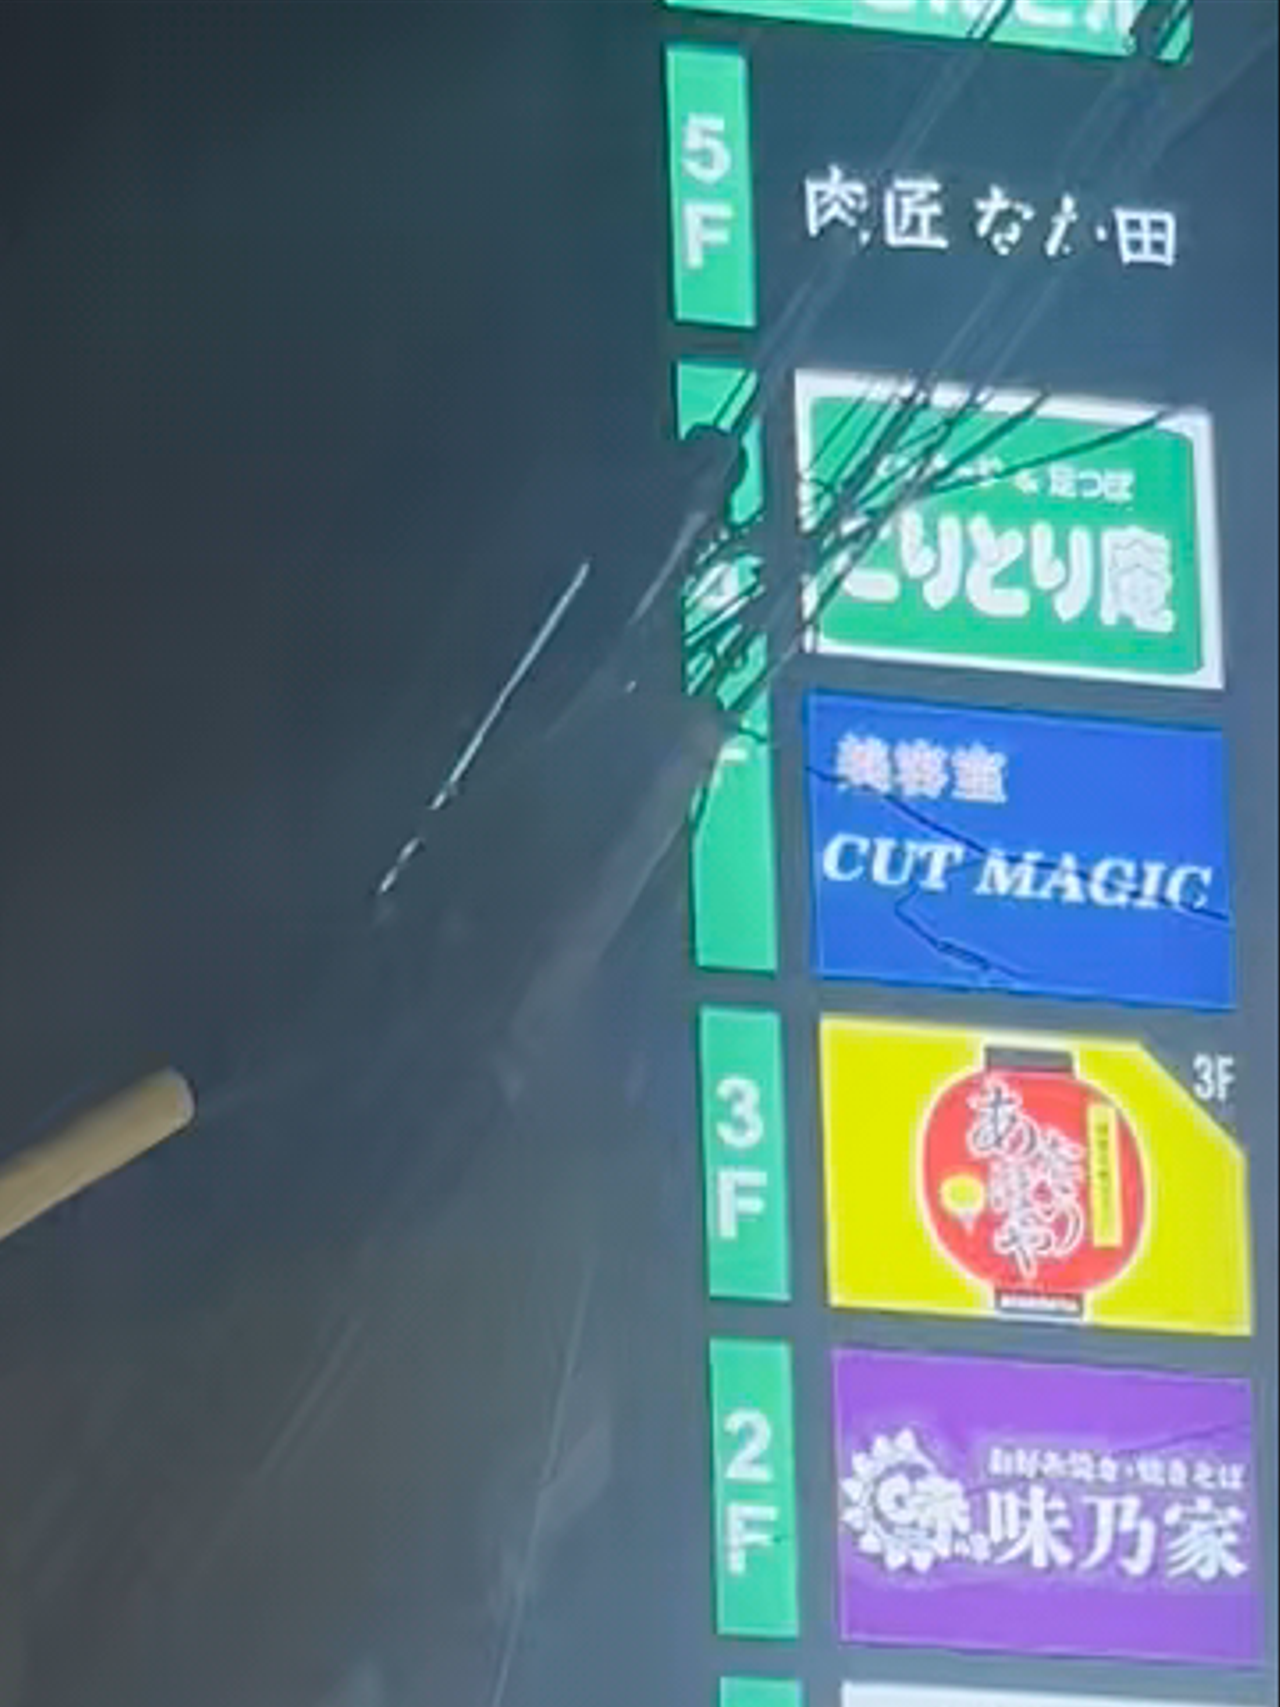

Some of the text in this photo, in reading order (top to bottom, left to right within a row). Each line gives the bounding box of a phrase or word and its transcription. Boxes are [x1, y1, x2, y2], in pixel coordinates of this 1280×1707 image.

[803, 163, 948, 250] 肉匠
[837, 732, 1008, 803] 美容室
[822, 834, 1212, 911] CUT MAGIC
[1192, 1054, 1236, 1103] 3F
[986, 1484, 1249, 1580] 味乃家
